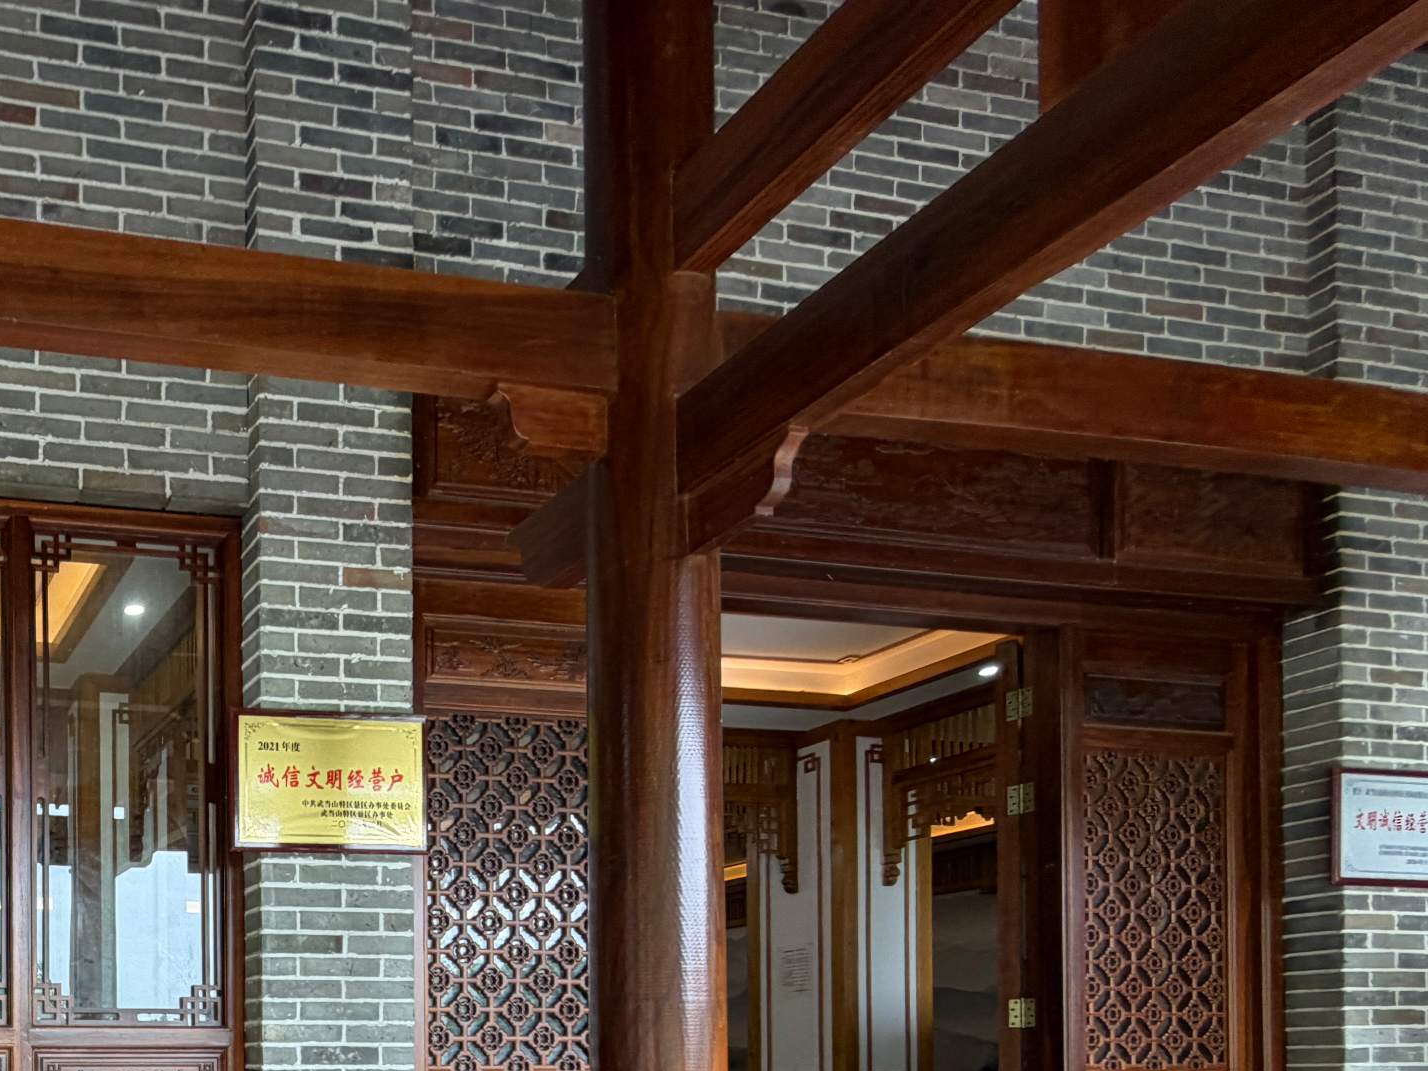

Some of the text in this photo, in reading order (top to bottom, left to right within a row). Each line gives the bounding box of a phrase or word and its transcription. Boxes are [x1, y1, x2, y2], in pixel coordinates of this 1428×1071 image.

[257, 741, 301, 752] 2021年度
[257, 763, 405, 792] 诚信文明经营户
